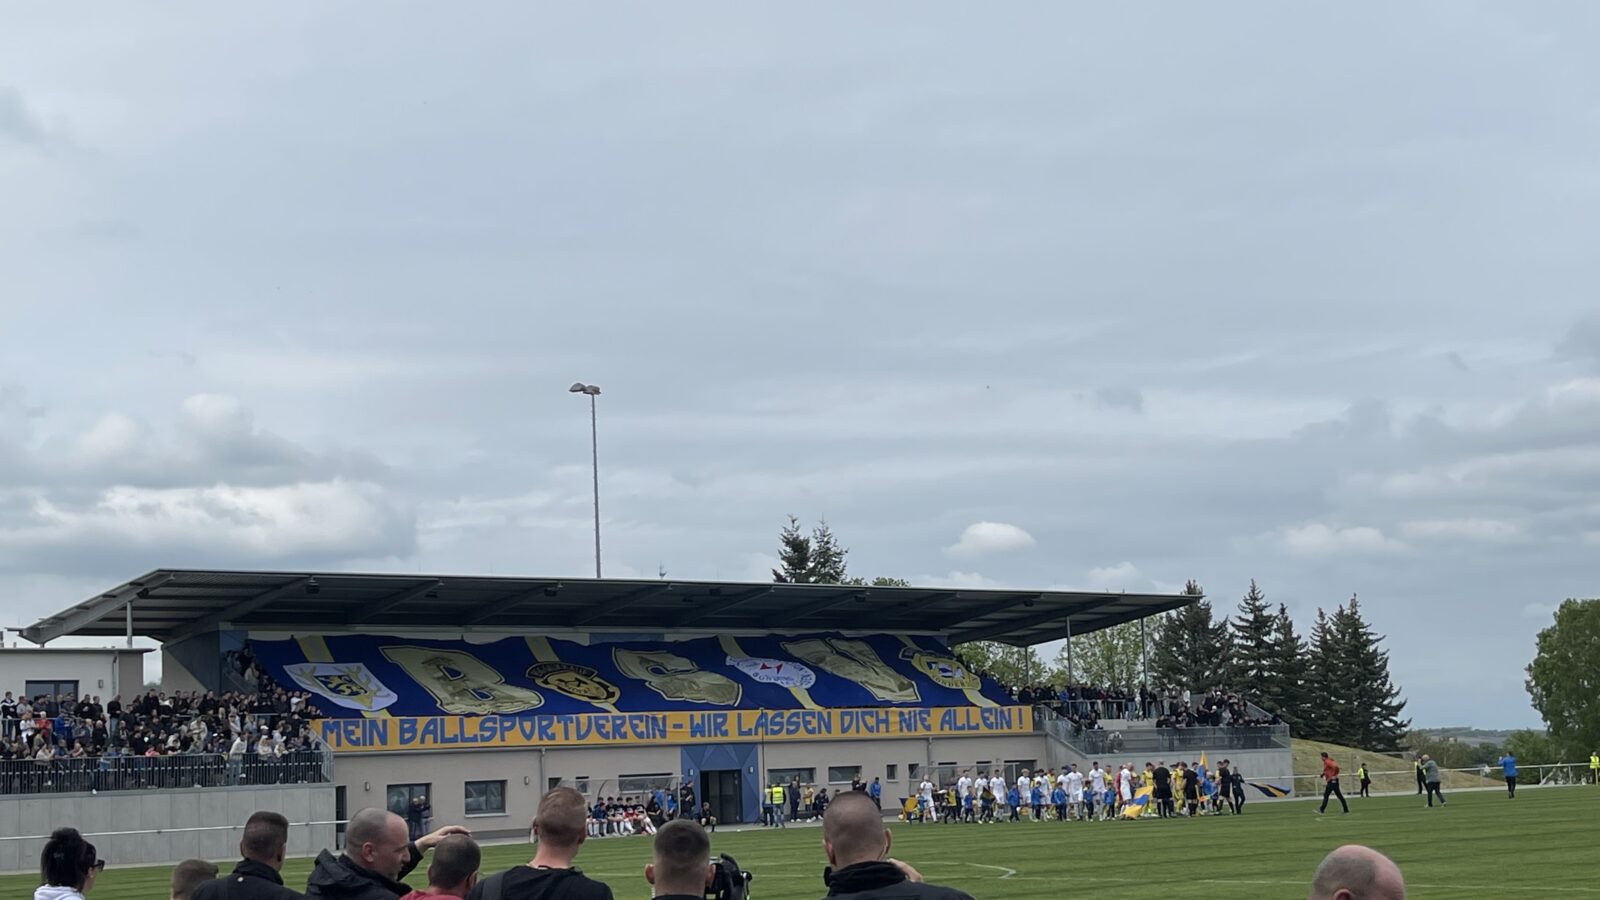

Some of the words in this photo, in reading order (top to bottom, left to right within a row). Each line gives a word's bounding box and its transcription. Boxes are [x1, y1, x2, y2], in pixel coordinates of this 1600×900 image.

[379, 646, 544, 714] B
[321, 719, 388, 747] MEIN
[400, 713, 667, 745] BALLSPORTVEREIN
[689, 713, 729, 738] WIR
[737, 711, 832, 736] LASSEN
[840, 710, 890, 734] DICH
[899, 709, 932, 733] NIE
